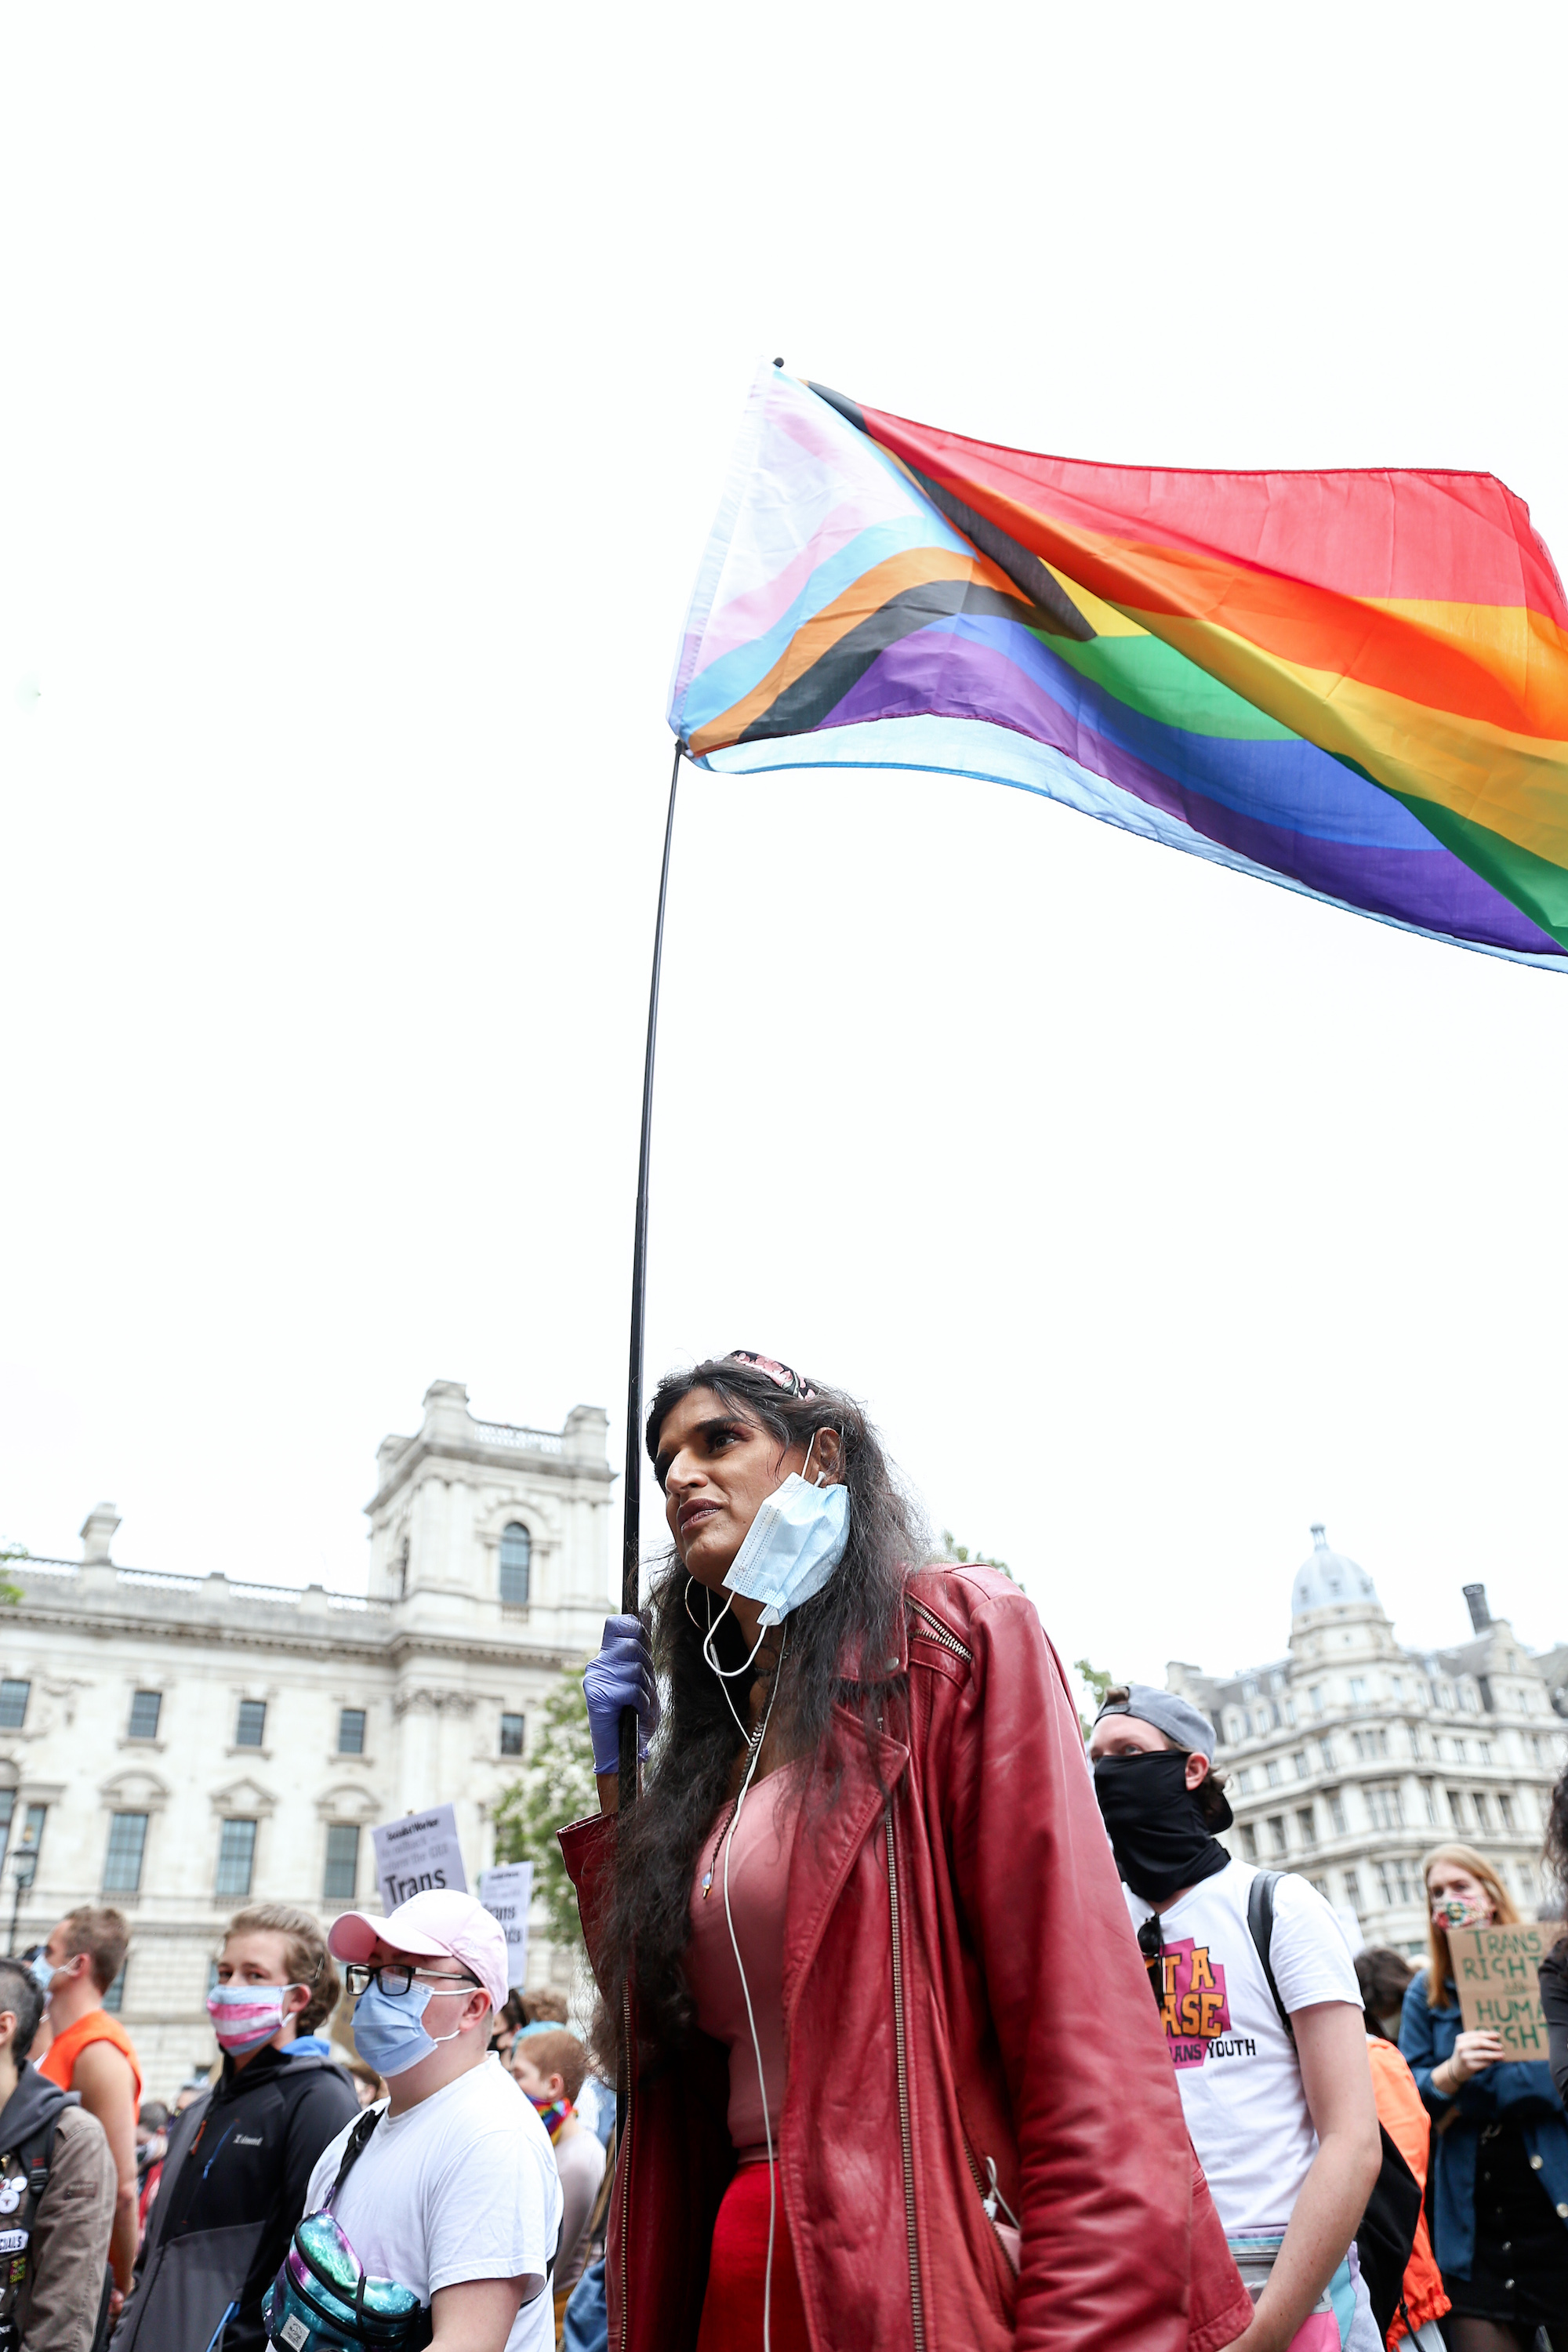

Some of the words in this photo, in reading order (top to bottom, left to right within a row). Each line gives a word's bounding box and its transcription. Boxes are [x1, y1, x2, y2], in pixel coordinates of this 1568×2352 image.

[385, 1869, 446, 1904] Trans
[1465, 1928, 1542, 1956] TRANS
[1189, 1946, 1216, 1992] A
[1207, 2038, 1257, 2059] YOUTH
